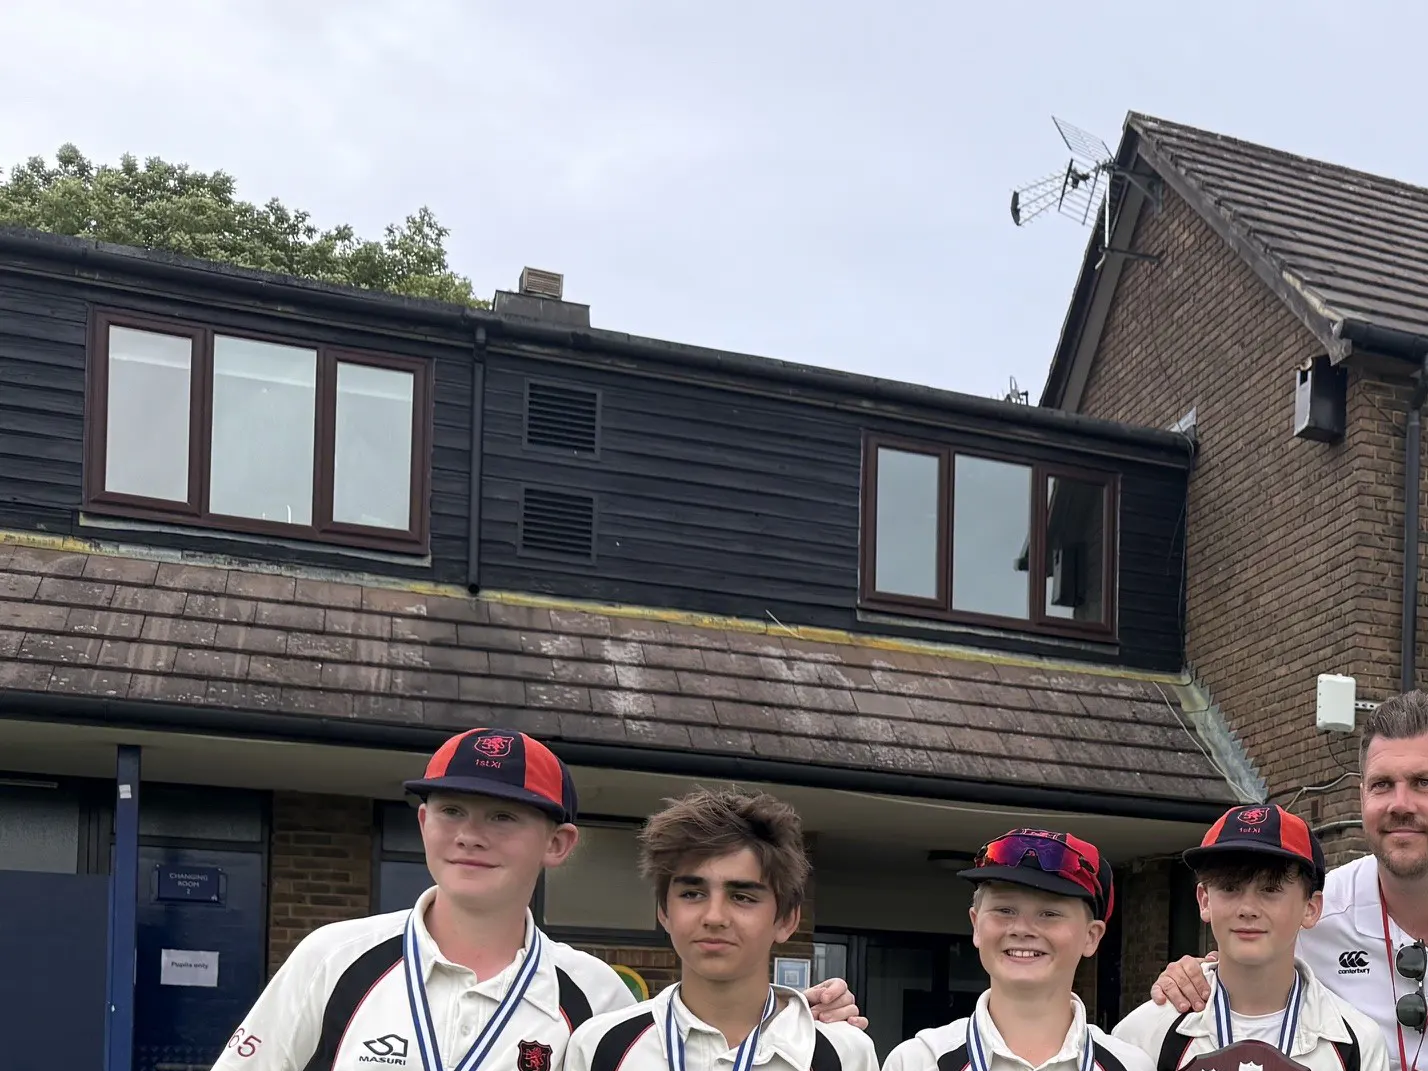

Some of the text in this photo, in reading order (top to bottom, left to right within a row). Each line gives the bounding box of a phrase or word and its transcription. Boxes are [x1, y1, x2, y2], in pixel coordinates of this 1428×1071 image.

[169, 872, 209, 882] CHANGING
[177, 880, 200, 888] ROOM
[171, 961, 209, 970] Pupils only
[358, 1055, 406, 1066] MASURI
